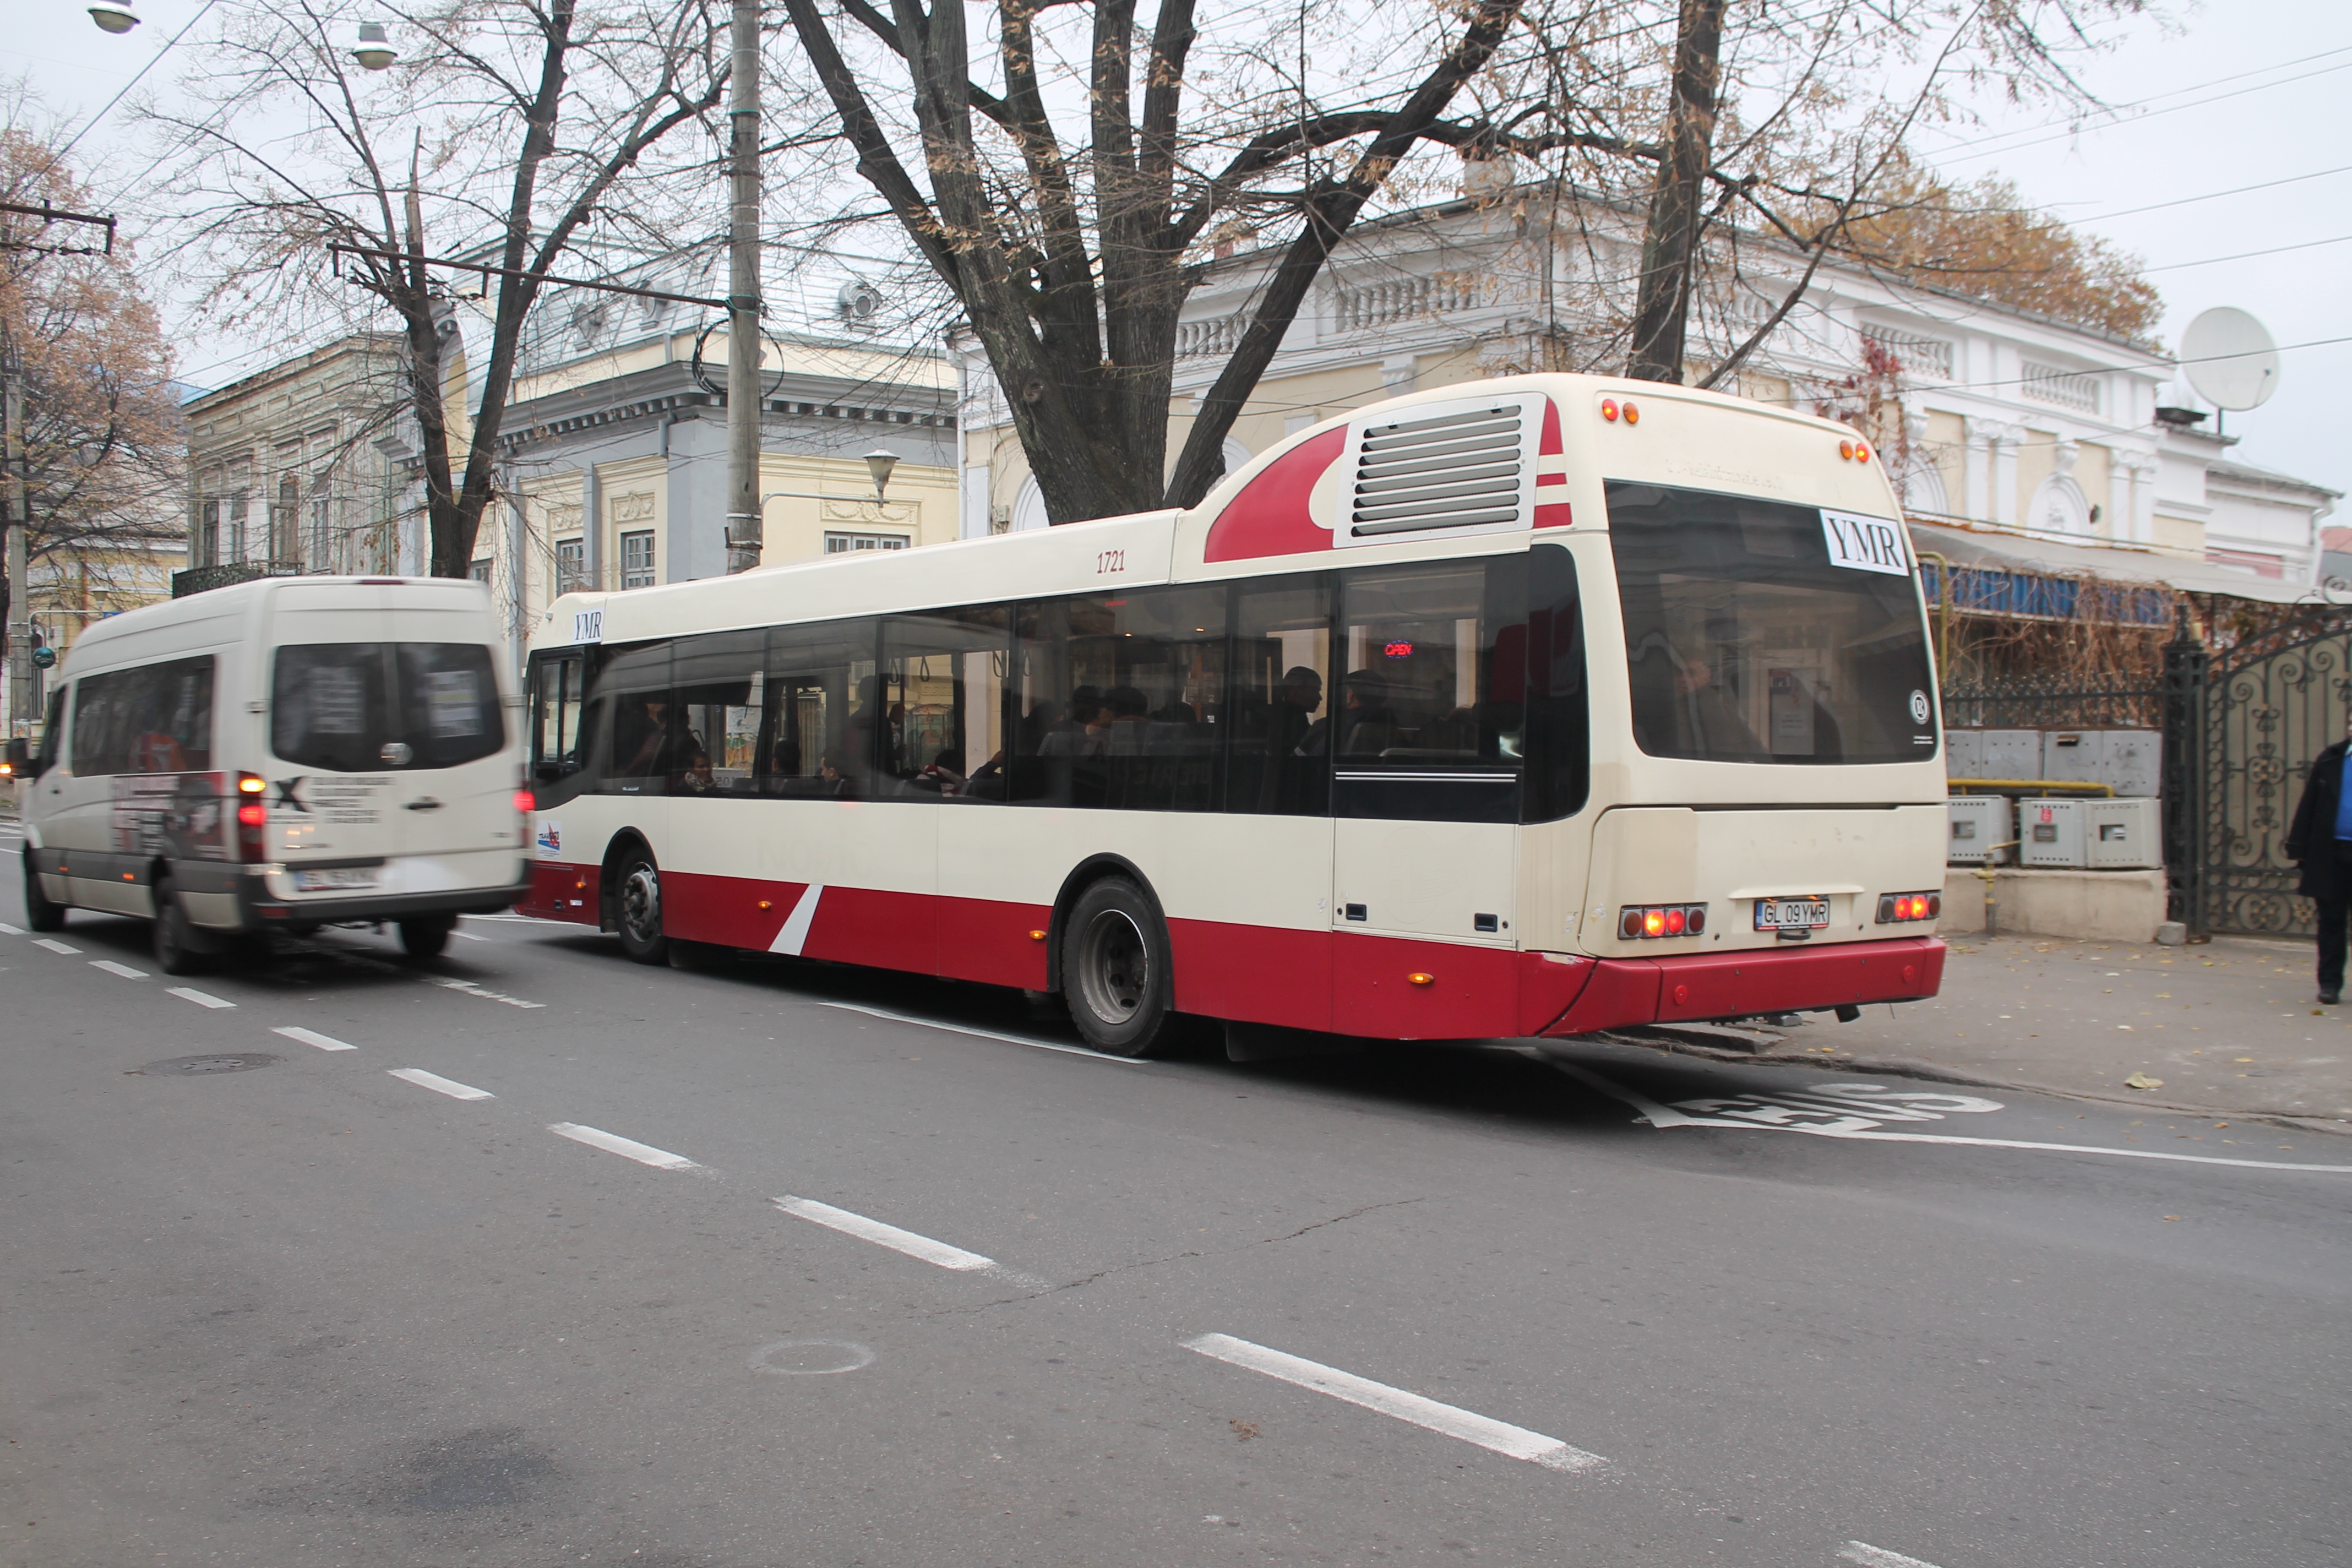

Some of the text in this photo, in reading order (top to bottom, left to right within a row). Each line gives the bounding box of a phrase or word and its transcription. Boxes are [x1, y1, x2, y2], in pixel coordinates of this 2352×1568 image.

[1827, 516, 1903, 568] YMR
[1097, 549, 1125, 574] 1721
[574, 611, 602, 640] YMR
[1765, 905, 1781, 923] GL
[1786, 904, 1800, 923] 09
[1802, 903, 1826, 923] YMR
